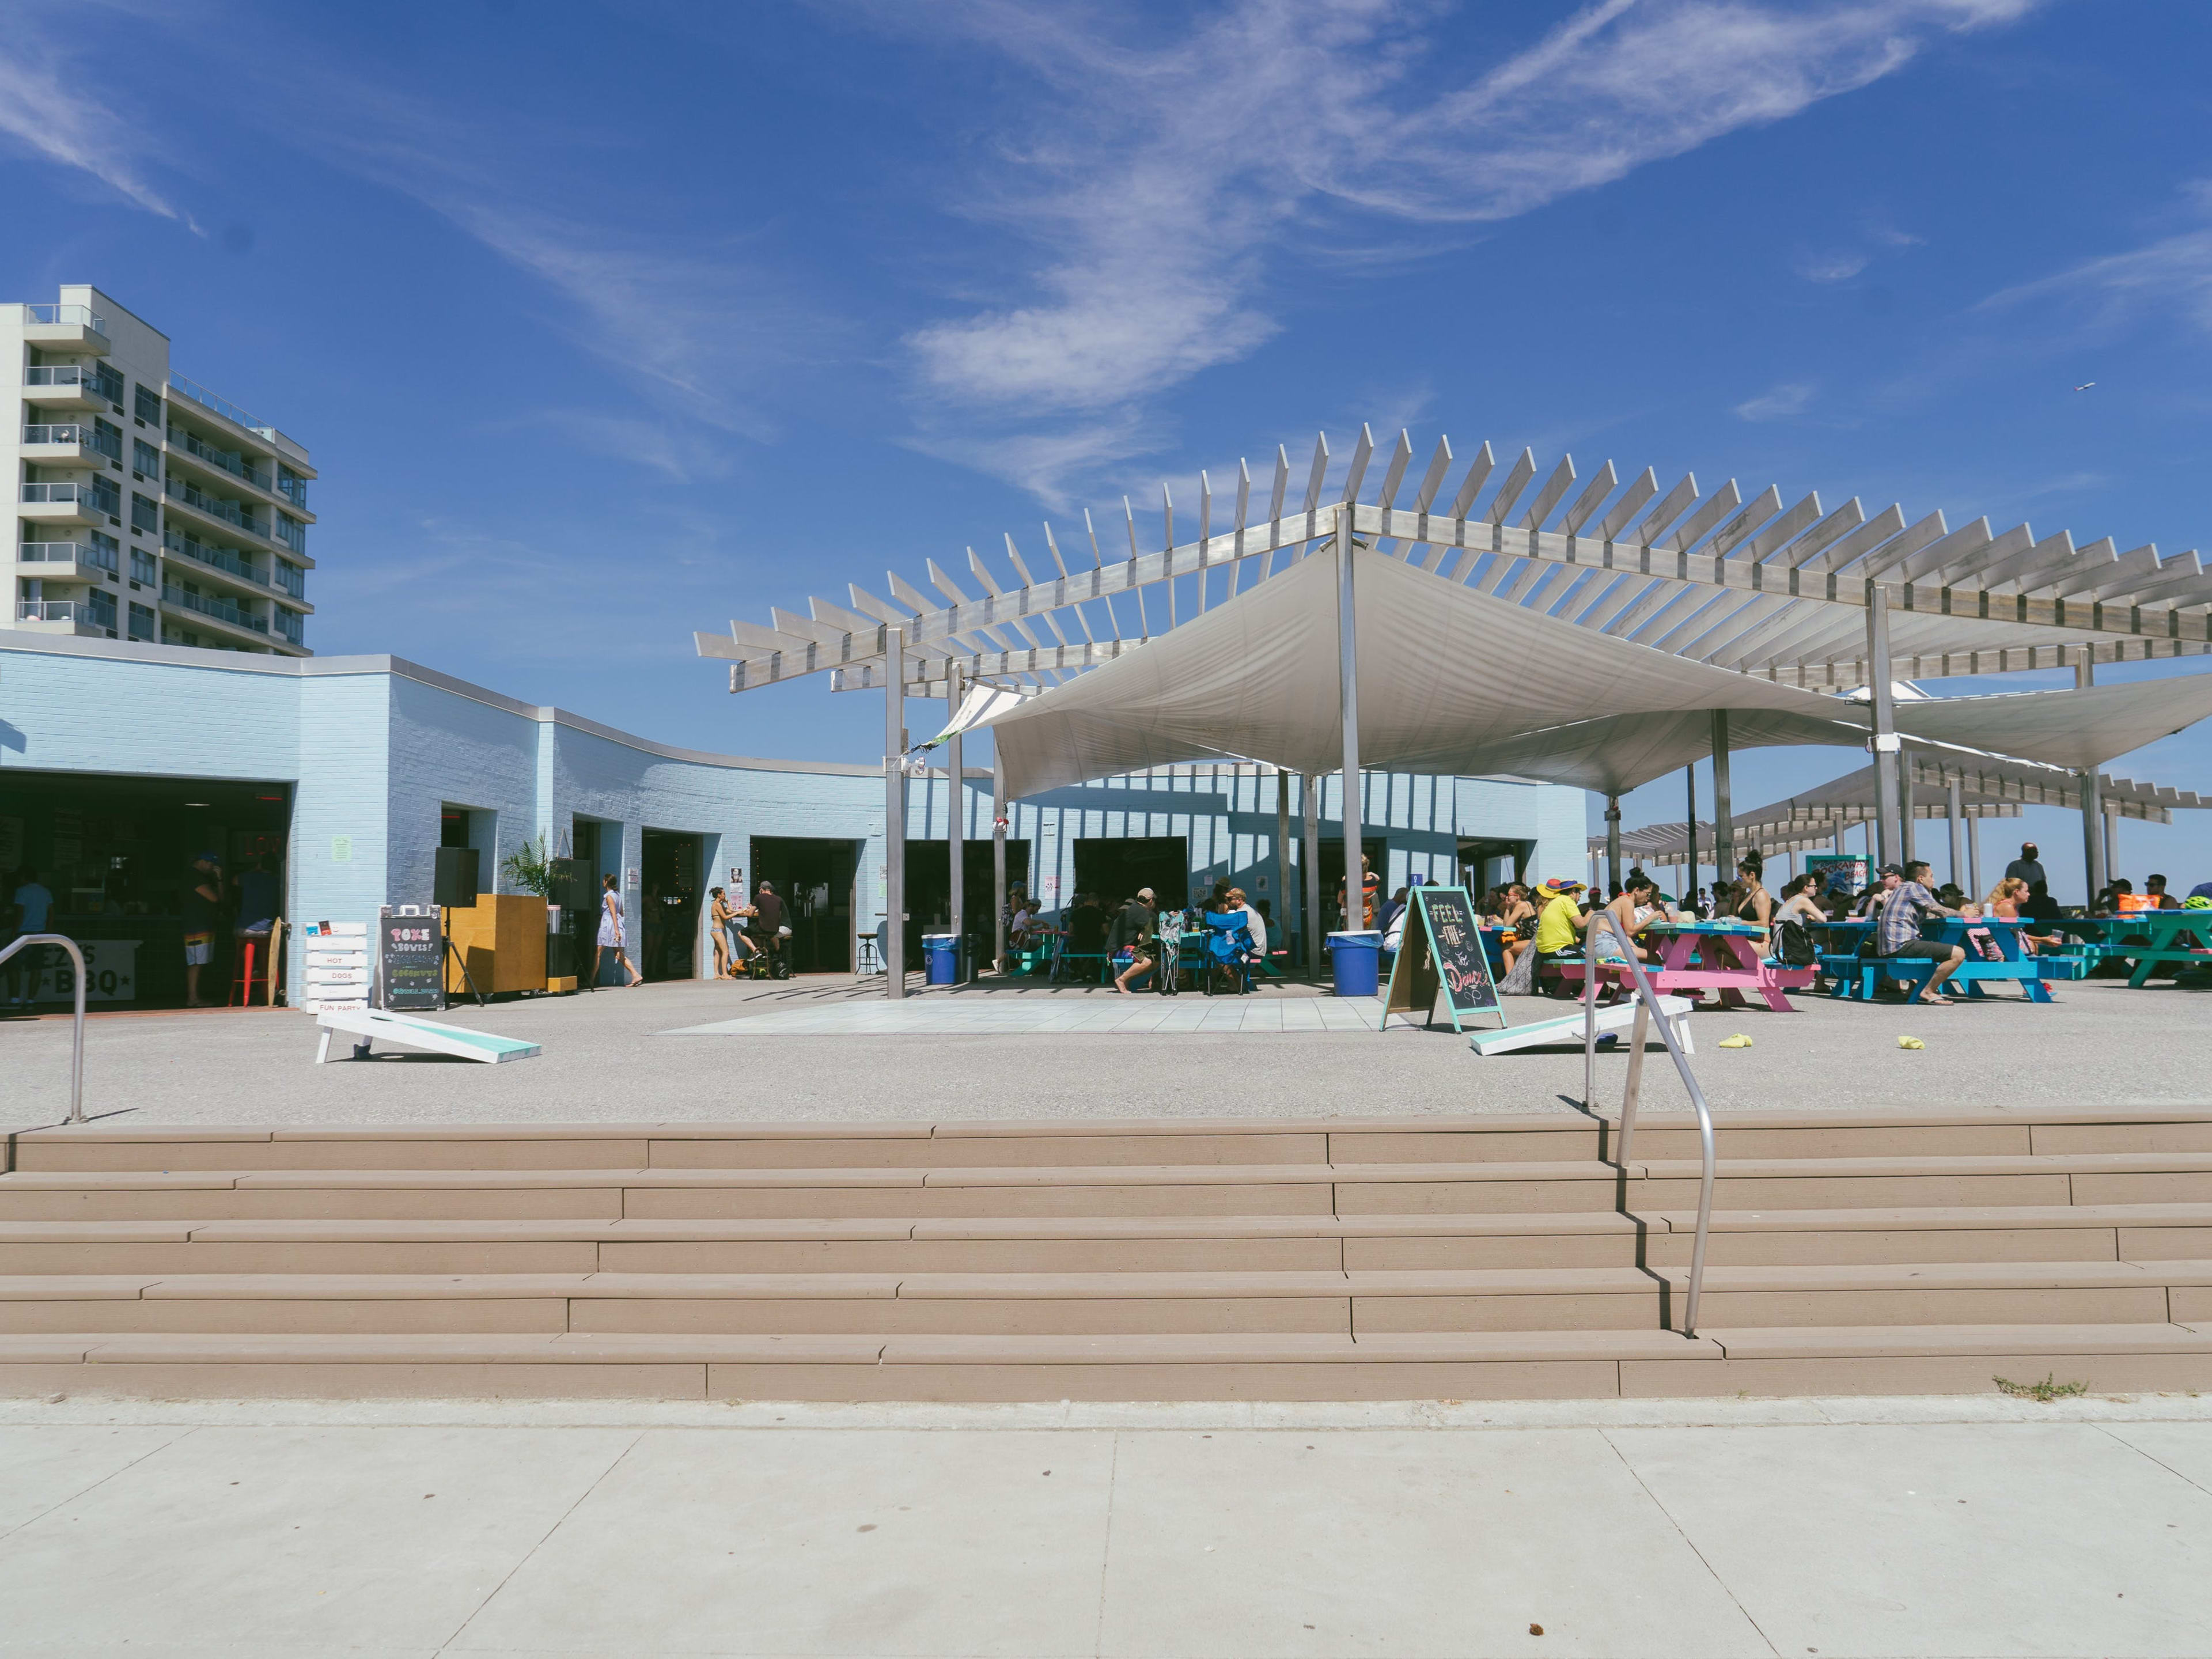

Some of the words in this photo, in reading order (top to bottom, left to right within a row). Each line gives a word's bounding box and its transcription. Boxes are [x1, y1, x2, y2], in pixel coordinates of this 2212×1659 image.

[1844, 870, 1868, 881] BEACH
[1431, 904, 1463, 922] FEEL
[391, 929, 430, 942] POKE
[392, 969, 438, 978] COCONUTS
[1442, 961, 1488, 993] Dance
[55, 969, 118, 996] BBQ
